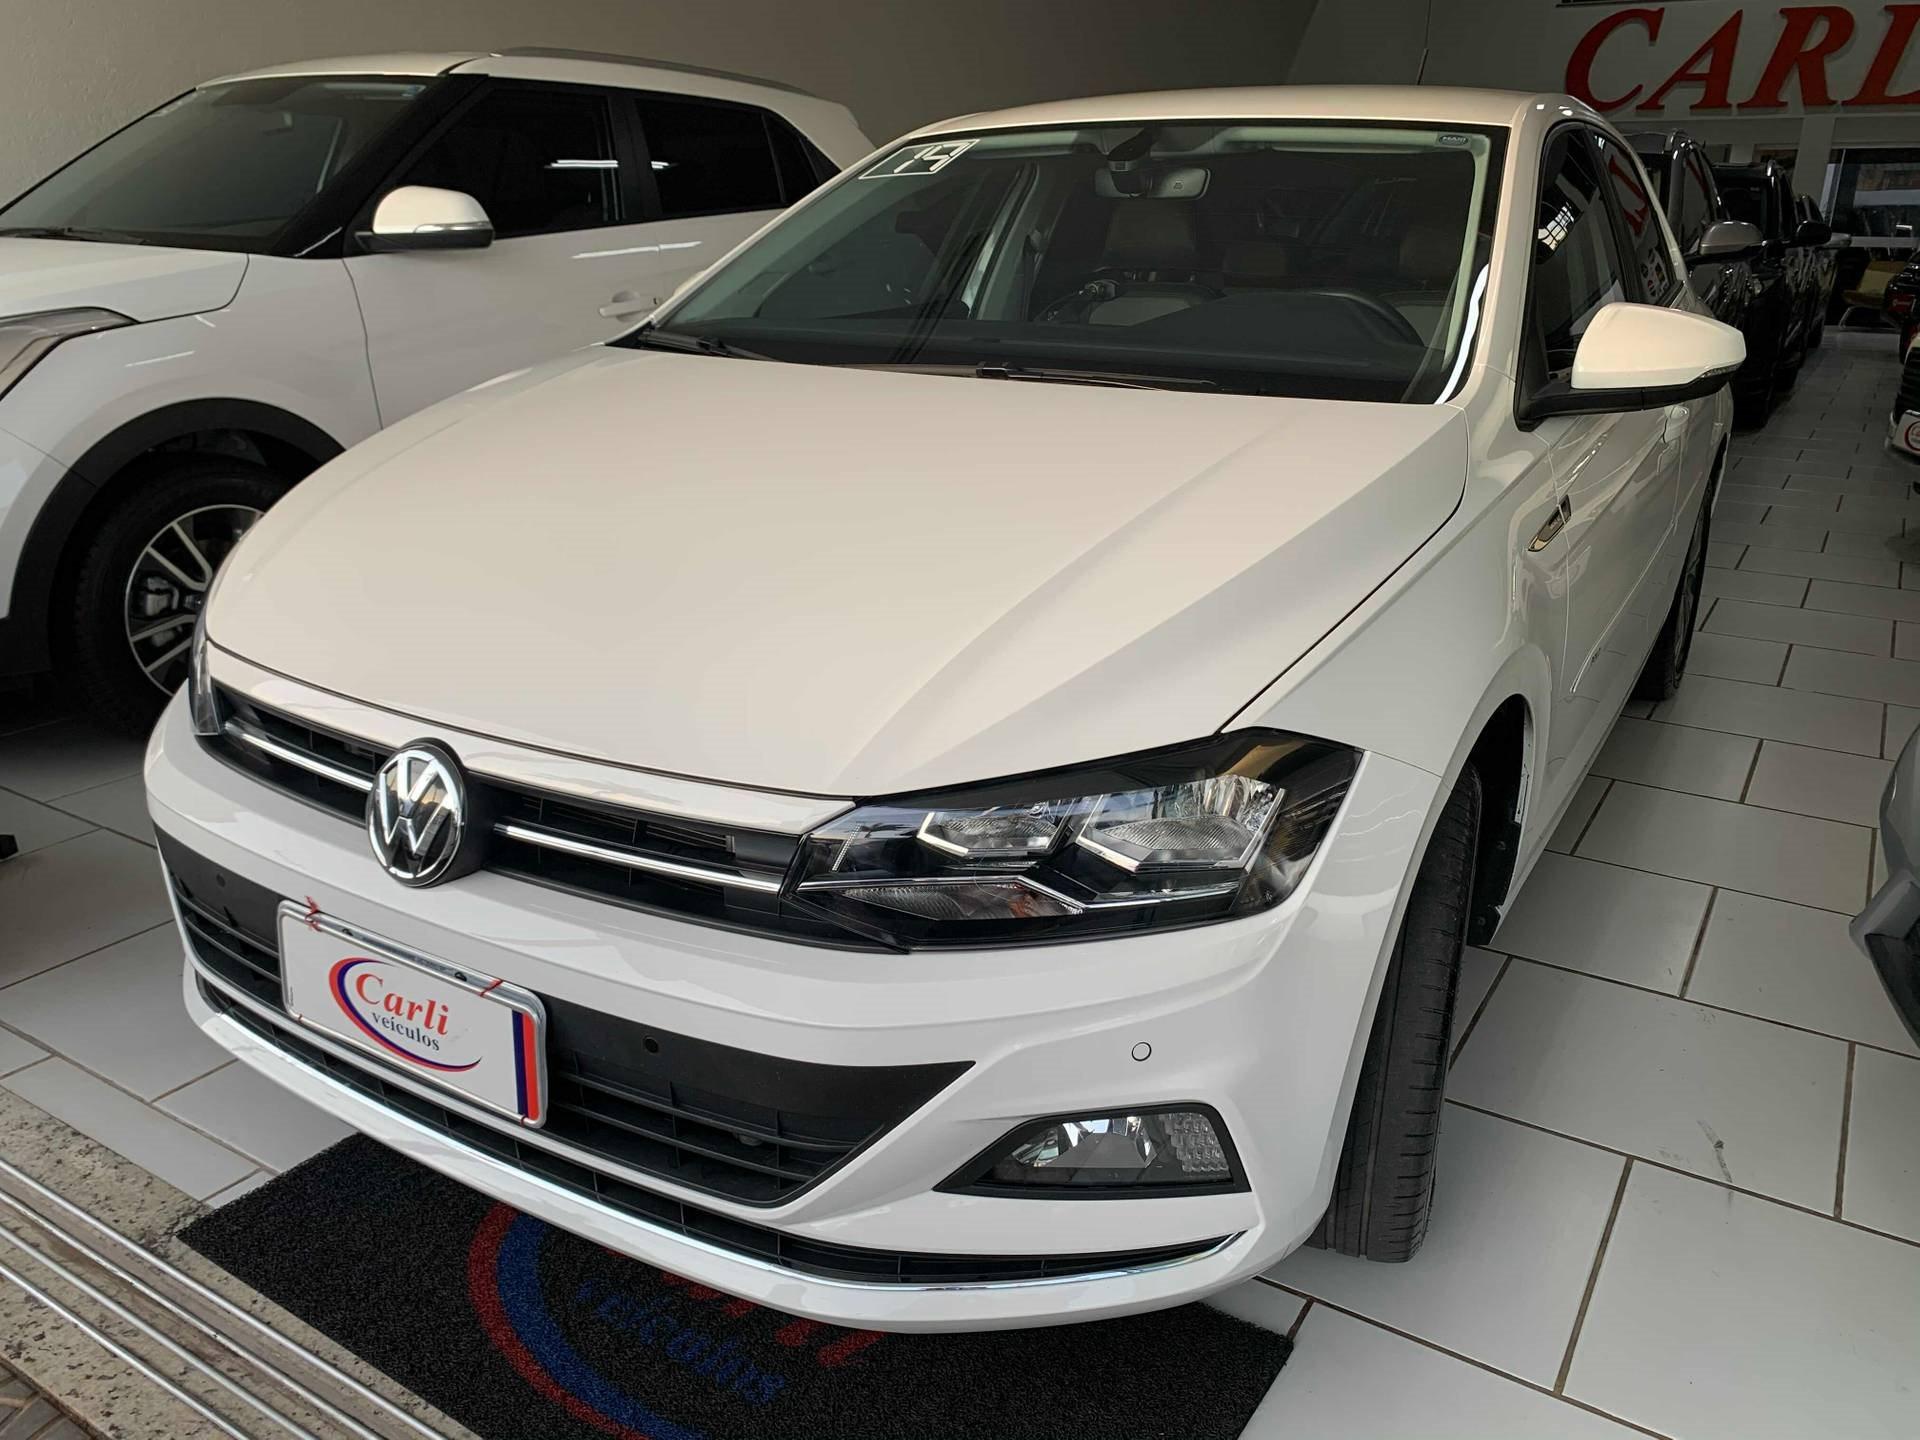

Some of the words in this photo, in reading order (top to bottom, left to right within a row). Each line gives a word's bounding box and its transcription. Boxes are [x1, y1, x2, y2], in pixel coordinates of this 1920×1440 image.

[893, 142, 970, 173] 19
[356, 973, 449, 1035] Carli
[371, 1011, 440, 1051] veículos
